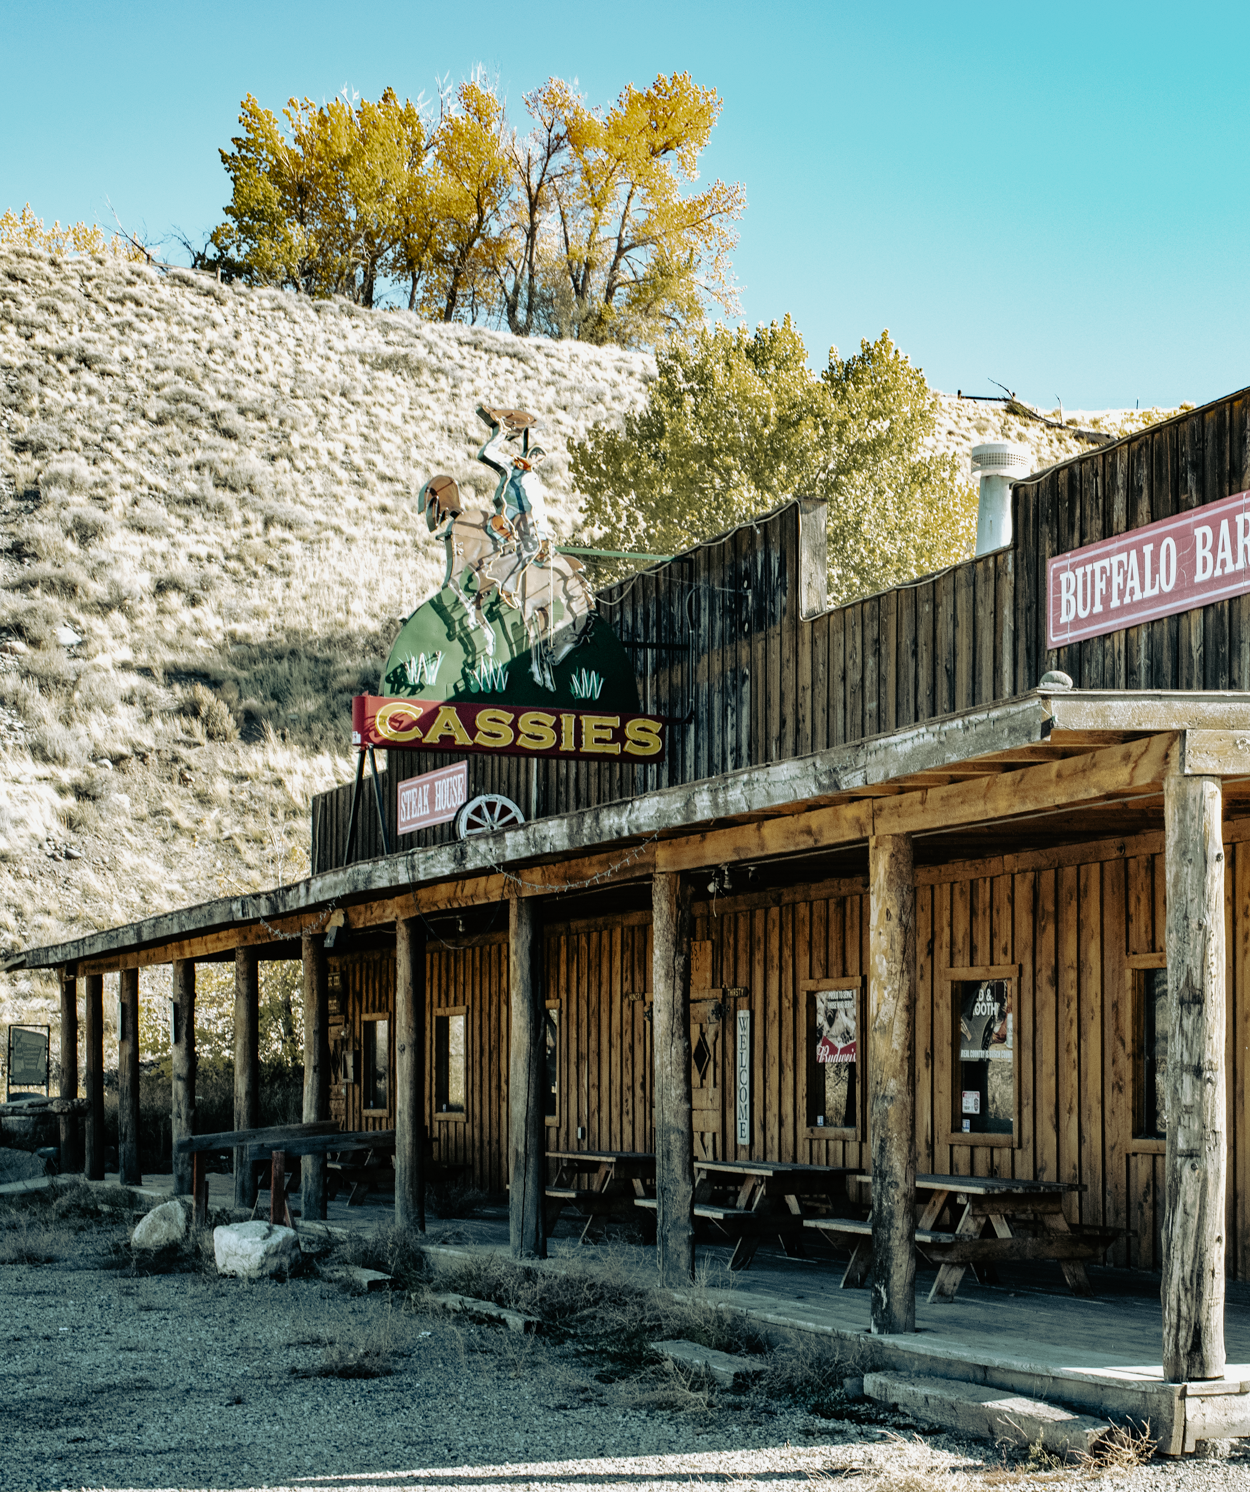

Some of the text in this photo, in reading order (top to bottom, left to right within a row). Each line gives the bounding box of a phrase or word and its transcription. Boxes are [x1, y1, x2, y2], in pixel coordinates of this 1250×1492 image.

[1059, 537, 1177, 624] BUFFALO
[375, 701, 663, 755] CASSIES
[400, 773, 464, 822] STEAK HOUSE
[973, 1002, 997, 1016] OOTH
[738, 1016, 749, 1138] WELCOME
